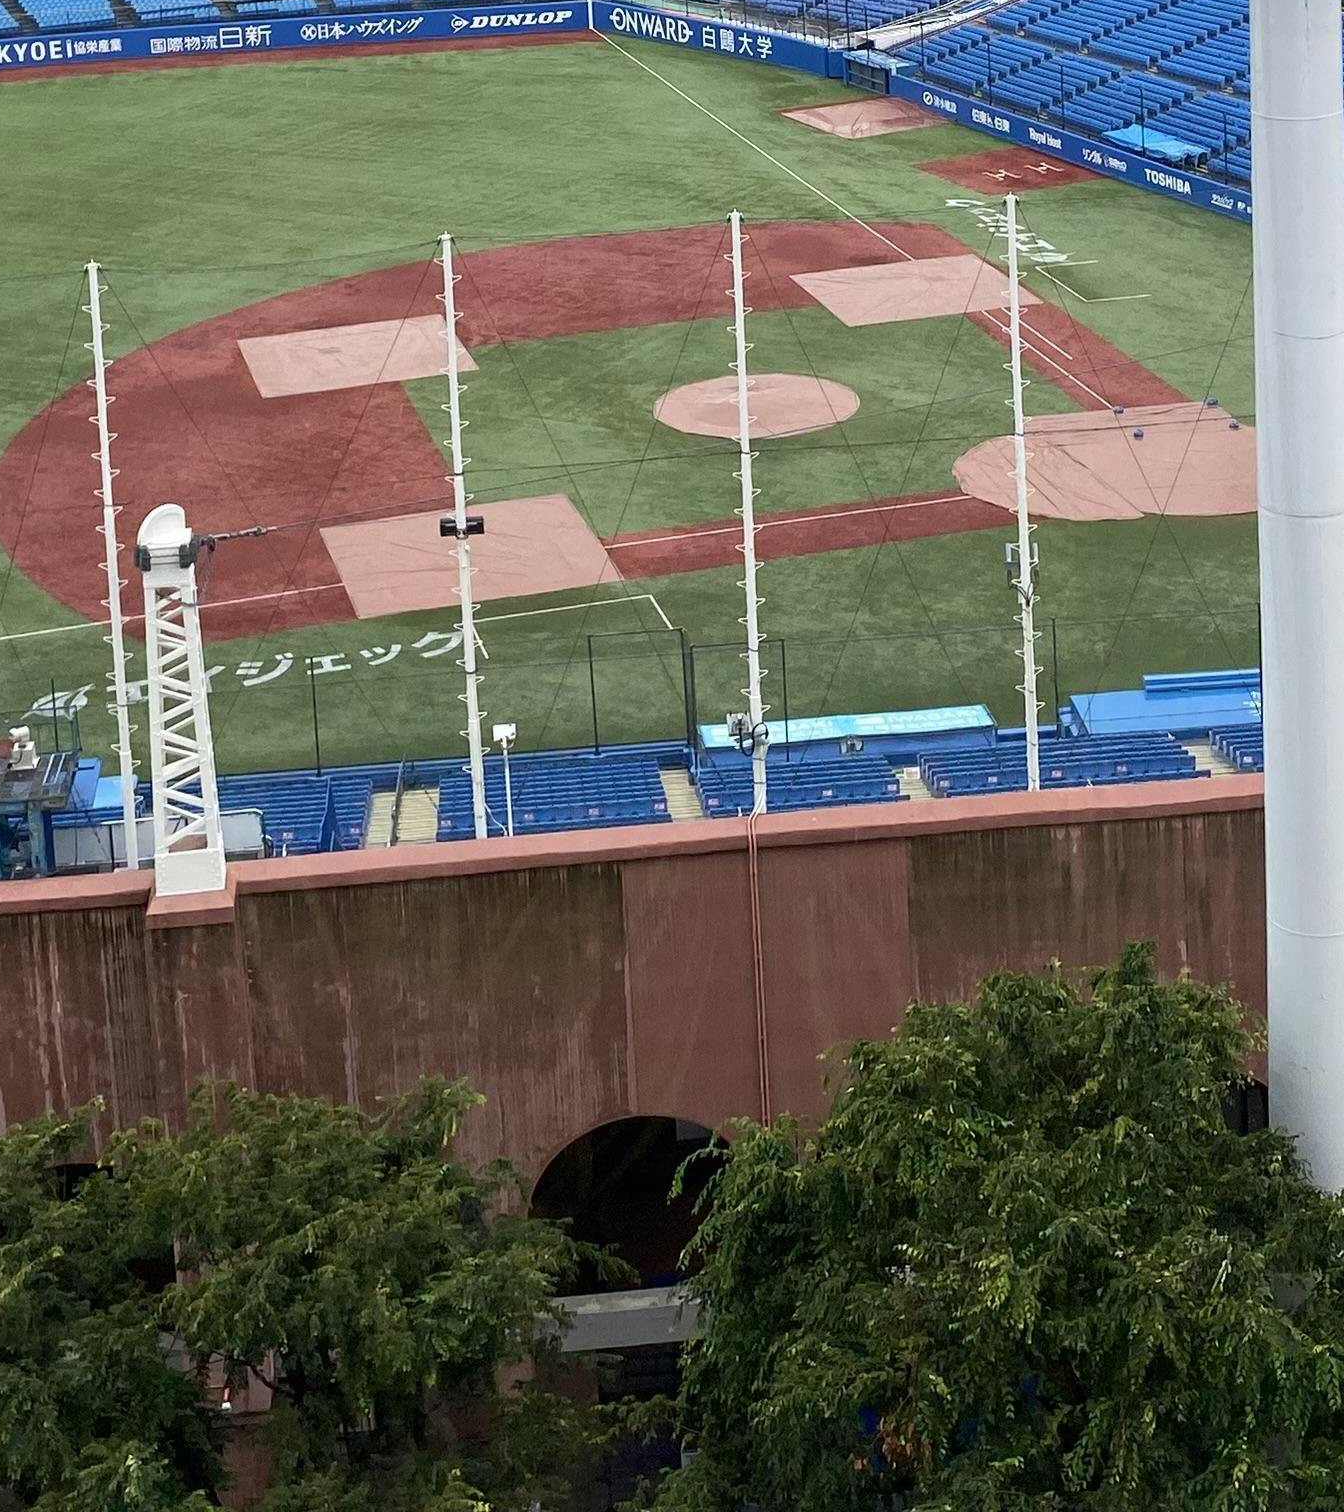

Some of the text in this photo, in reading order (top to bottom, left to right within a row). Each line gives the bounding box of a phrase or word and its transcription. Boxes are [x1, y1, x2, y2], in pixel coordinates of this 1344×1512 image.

[317, 16, 424, 40] 日本ハウズイング
[469, 10, 573, 29] DUNLOP
[609, 7, 694, 44] ONWARD
[1144, 168, 1192, 196] TOSHIBA
